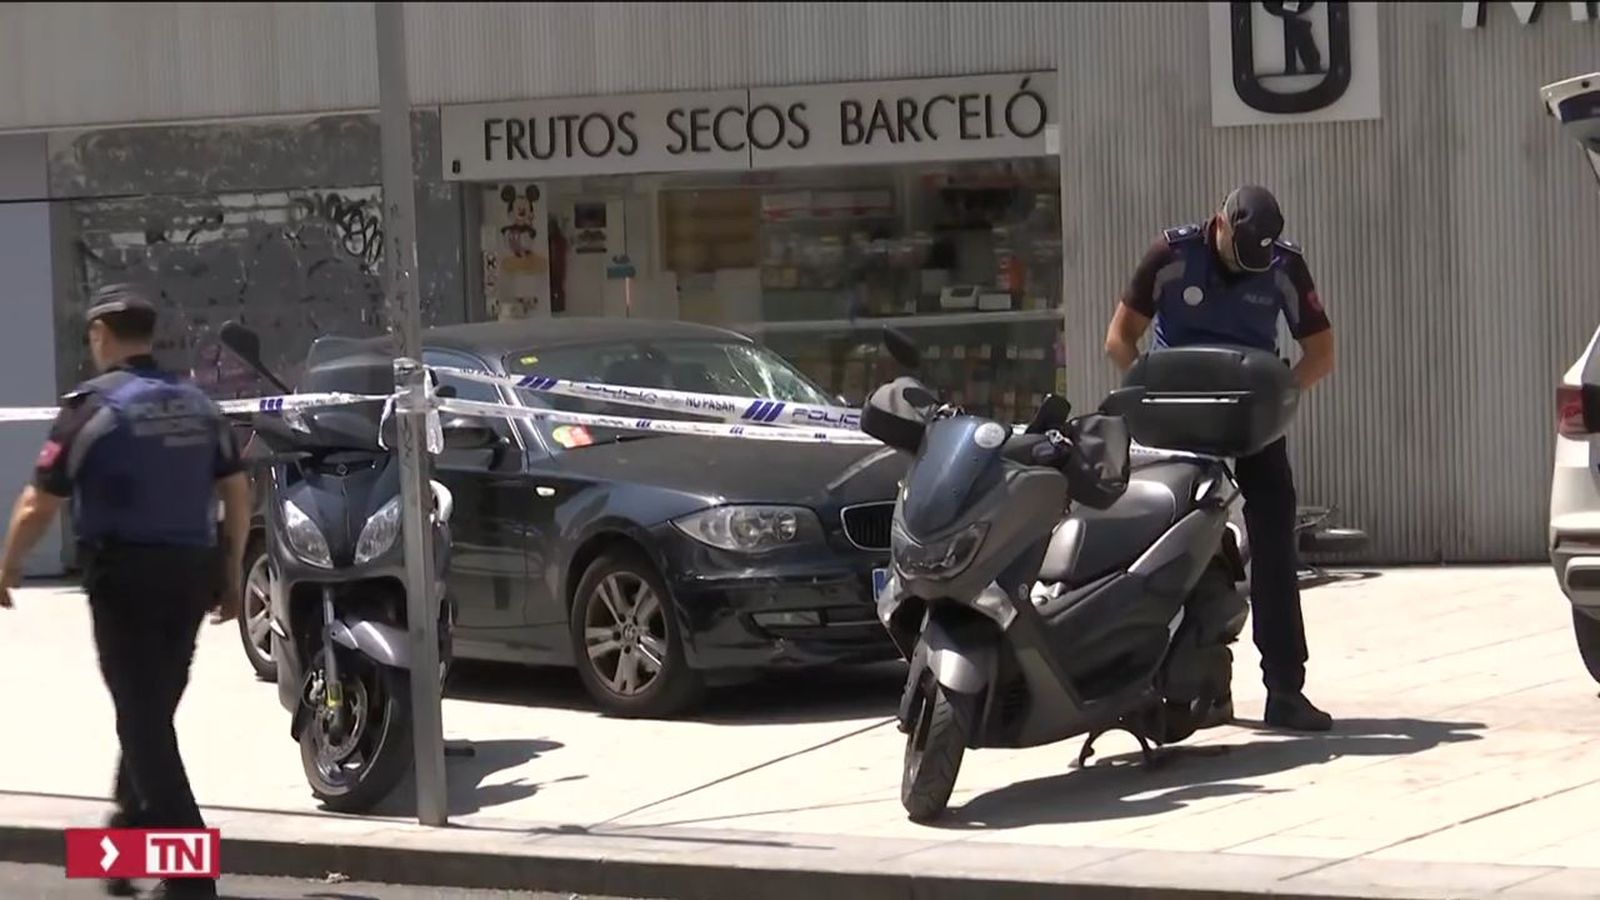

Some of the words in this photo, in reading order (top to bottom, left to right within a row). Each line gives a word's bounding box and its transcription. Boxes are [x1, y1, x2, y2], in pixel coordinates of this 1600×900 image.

[484, 111, 639, 160] FRUTOS
[665, 103, 810, 154] SECOS
[840, 77, 1047, 145] BARCELÓ
